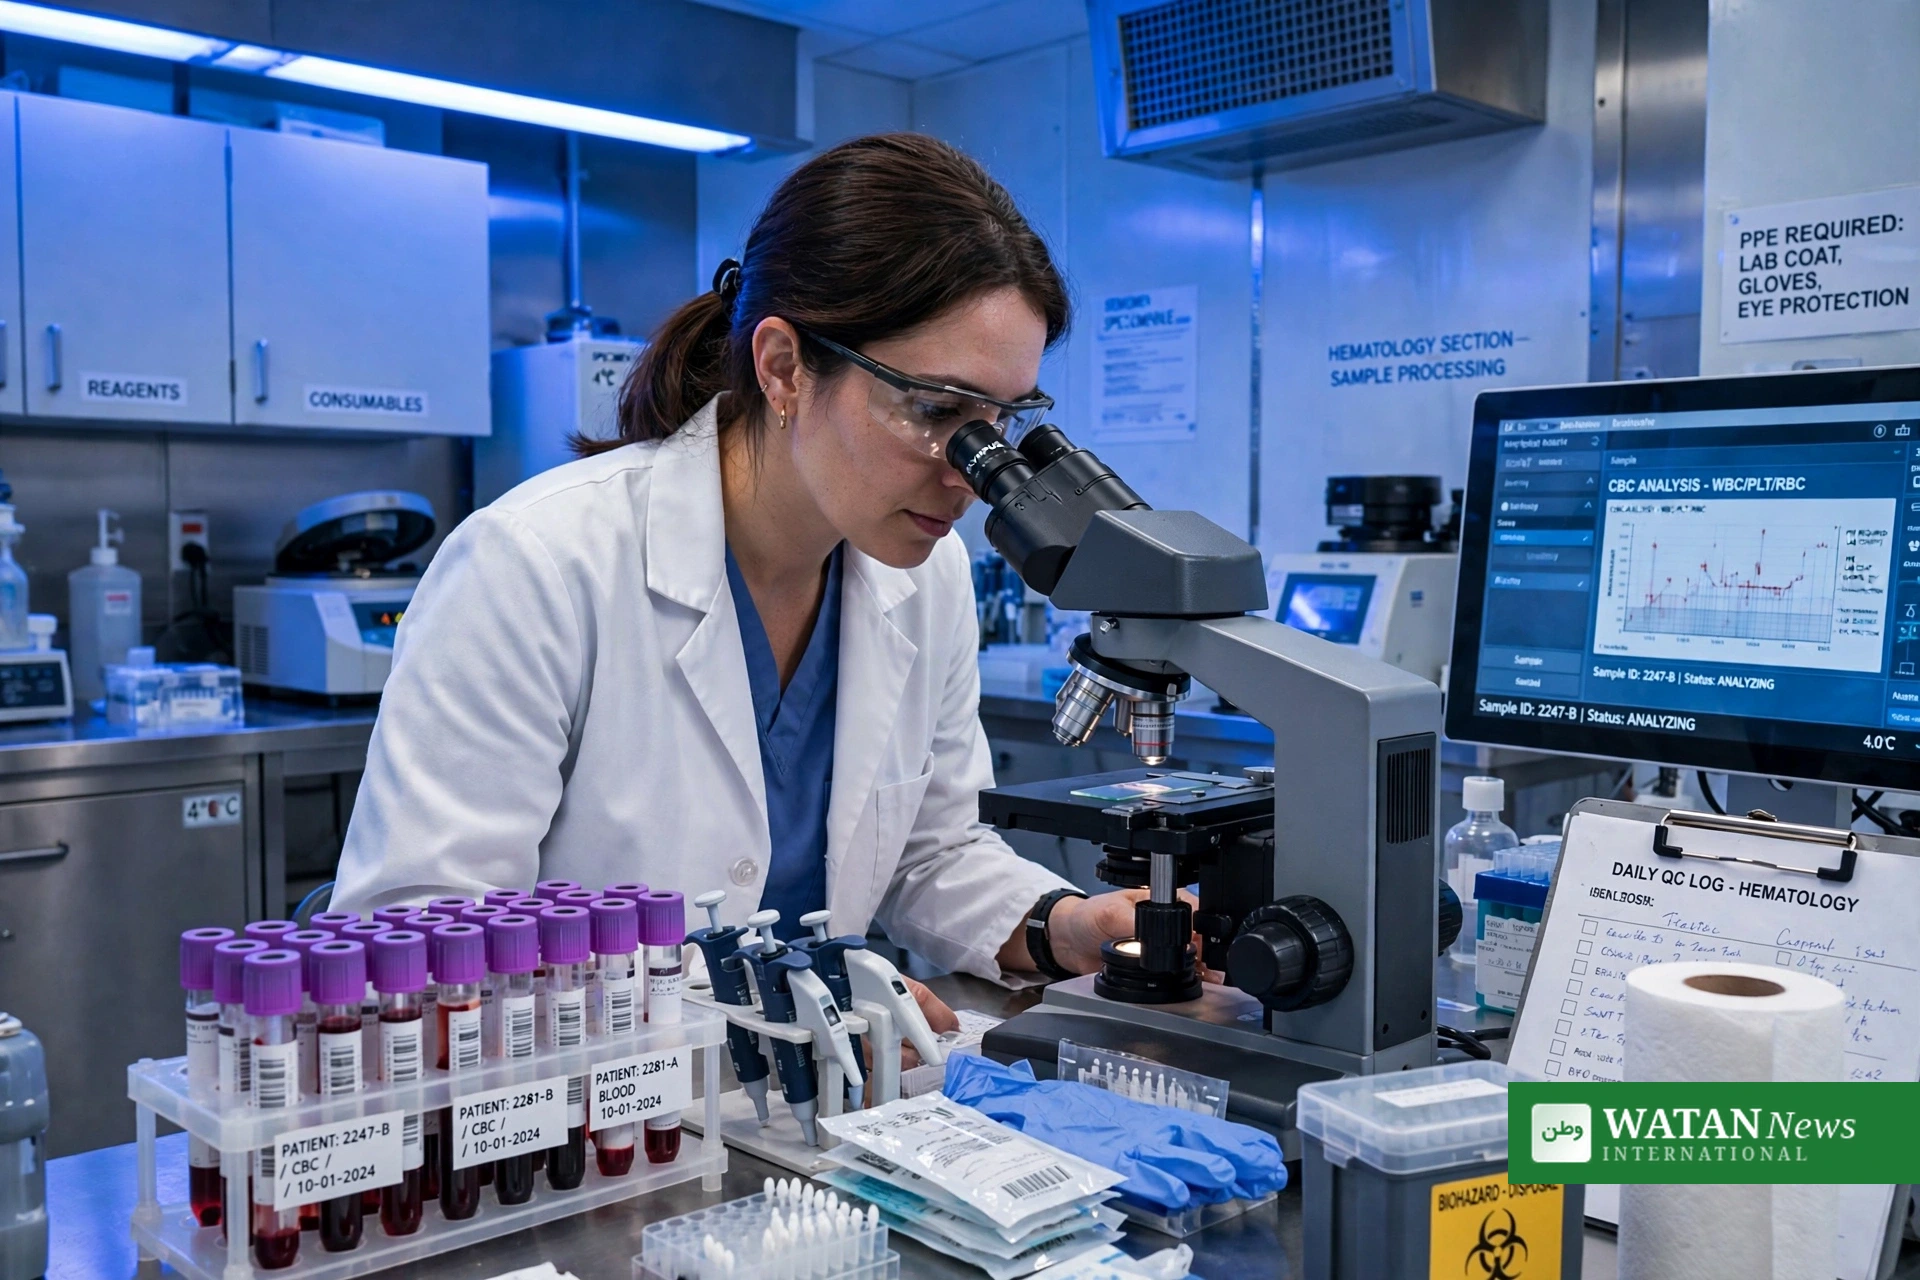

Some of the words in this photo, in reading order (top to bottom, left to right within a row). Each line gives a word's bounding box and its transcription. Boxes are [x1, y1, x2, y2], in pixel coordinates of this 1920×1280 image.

[1740, 228, 1779, 249] PPE
[1785, 214, 1904, 244] REQUIRED:
[1739, 252, 1778, 272] LAB
[1784, 245, 1842, 268] COAT,
[1738, 271, 1822, 295] GLOVES,
[1738, 299, 1774, 318] EYE
[1780, 287, 1909, 315] PROTECTION
[1328, 338, 1436, 362] HEMATOLOGY
[1439, 331, 1514, 354] SECTION
[1330, 366, 1393, 387] SAMPLE
[1397, 358, 1506, 382] PROCESSING
[87, 379, 181, 401] REAGENTS
[309, 391, 423, 413] CONSUMABLES
[1608, 479, 1635, 493] CBC
[1637, 478, 1701, 493] ANALYSIS
[1712, 477, 1806, 491] WBC/PLT/RBC
[1593, 666, 1626, 681] Sample
[1628, 669, 1641, 680] ID:
[1643, 670, 1676, 683] 2247-B
[1684, 673, 1716, 686] Status:
[1717, 675, 1775, 690] ANALYZING
[1479, 699, 1518, 716] Sample
[1520, 702, 1535, 716] ID:
[1538, 704, 1577, 720] 2247-B
[1587, 709, 1625, 725] Status:
[1627, 712, 1696, 731] ANALYZING
[1612, 862, 1659, 881] DAILY
[1661, 870, 1686, 886] QC
[1689, 873, 1725, 892] LOG
[1738, 881, 1859, 913] HEMATOLOGY
[595, 1065, 640, 1085] PATIENT:
[642, 1056, 679, 1076] 2281-A
[460, 1098, 510, 1120] PATIENT:
[512, 1088, 553, 1110] 2281-B
[599, 1083, 636, 1103] BLOOD
[601, 1095, 662, 1120] 10-01-2024
[282, 1133, 340, 1158] PATIENT:
[342, 1122, 390, 1145] 2247-B
[471, 1119, 496, 1136] CBC
[474, 1127, 540, 1154] 10-01-2024
[291, 1157, 319, 1175] CBC
[298, 1164, 376, 1194] 10-01-2024
[1438, 1184, 1499, 1212] BIOHAZARD
